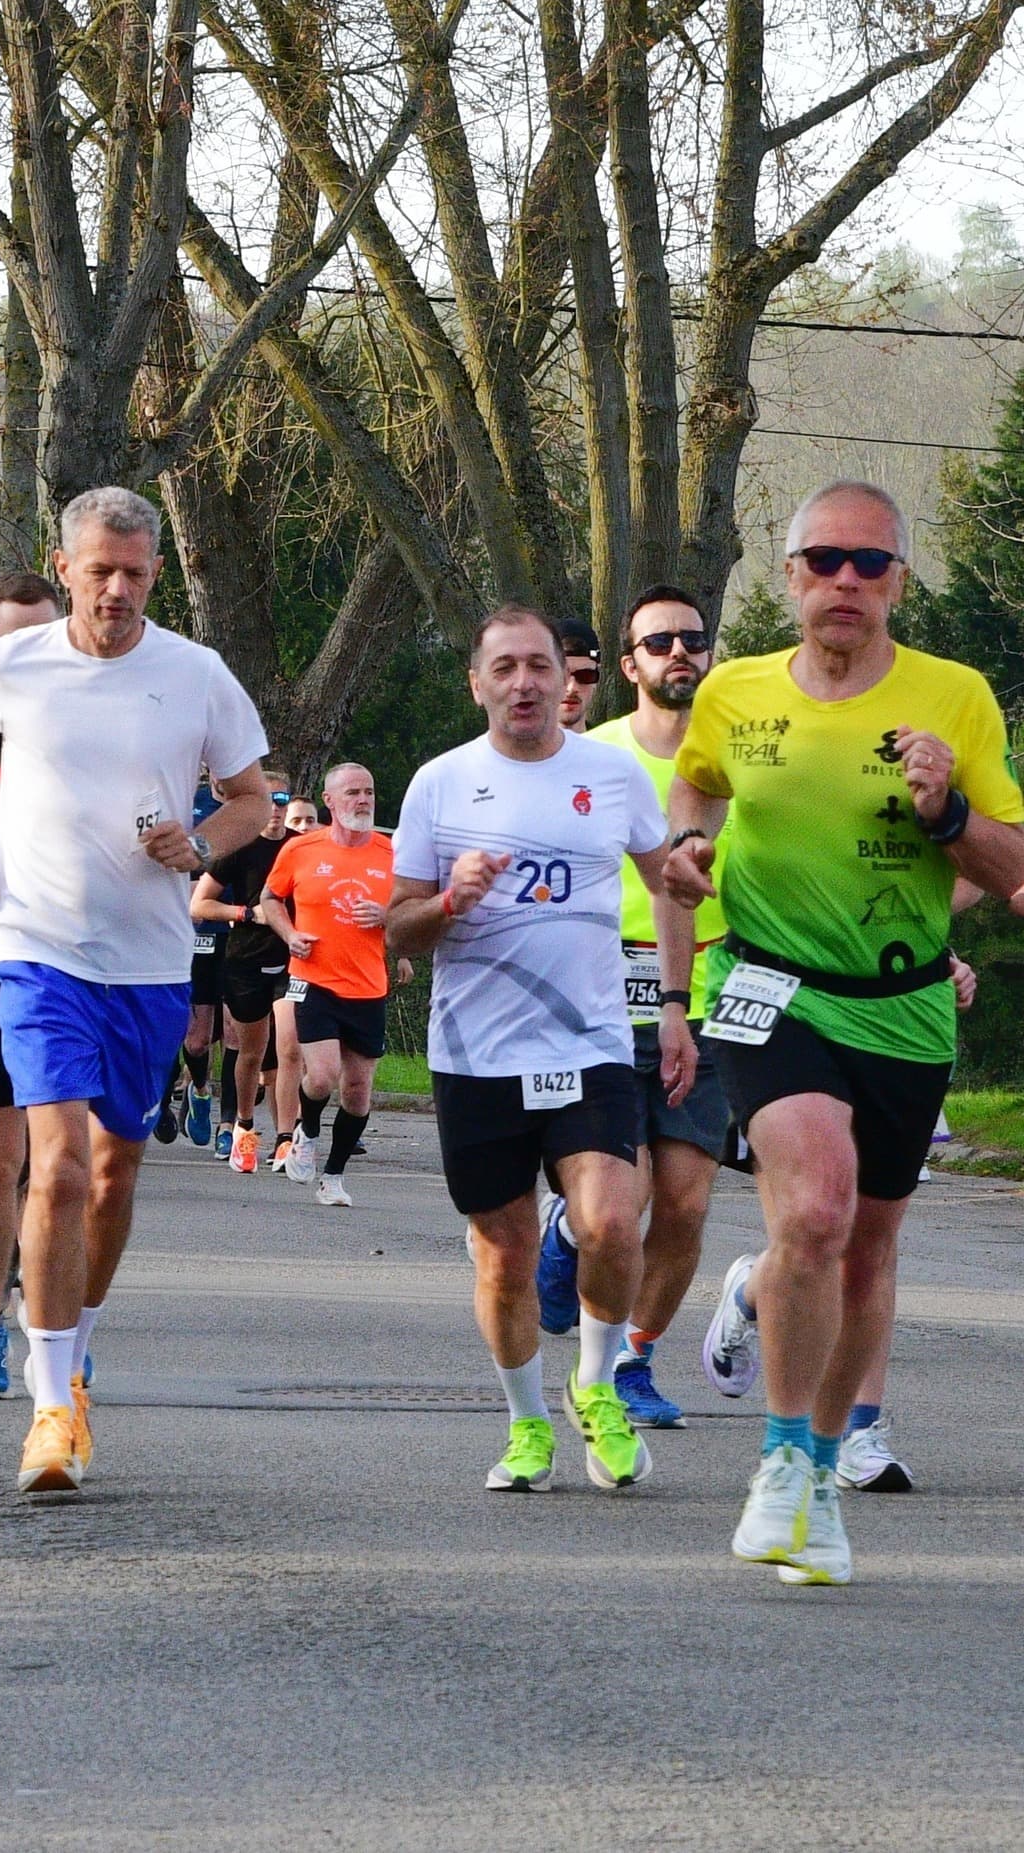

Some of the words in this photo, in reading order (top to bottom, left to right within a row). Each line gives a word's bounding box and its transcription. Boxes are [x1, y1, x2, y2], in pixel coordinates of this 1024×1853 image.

[862, 764, 903, 778] DOLTC
[858, 839, 922, 858] BARON
[515, 859, 572, 904] 20
[630, 964, 661, 973] VERZEL
[627, 982, 661, 1003] 756
[716, 997, 778, 1030] 7400
[533, 1071, 575, 1092] 8422
